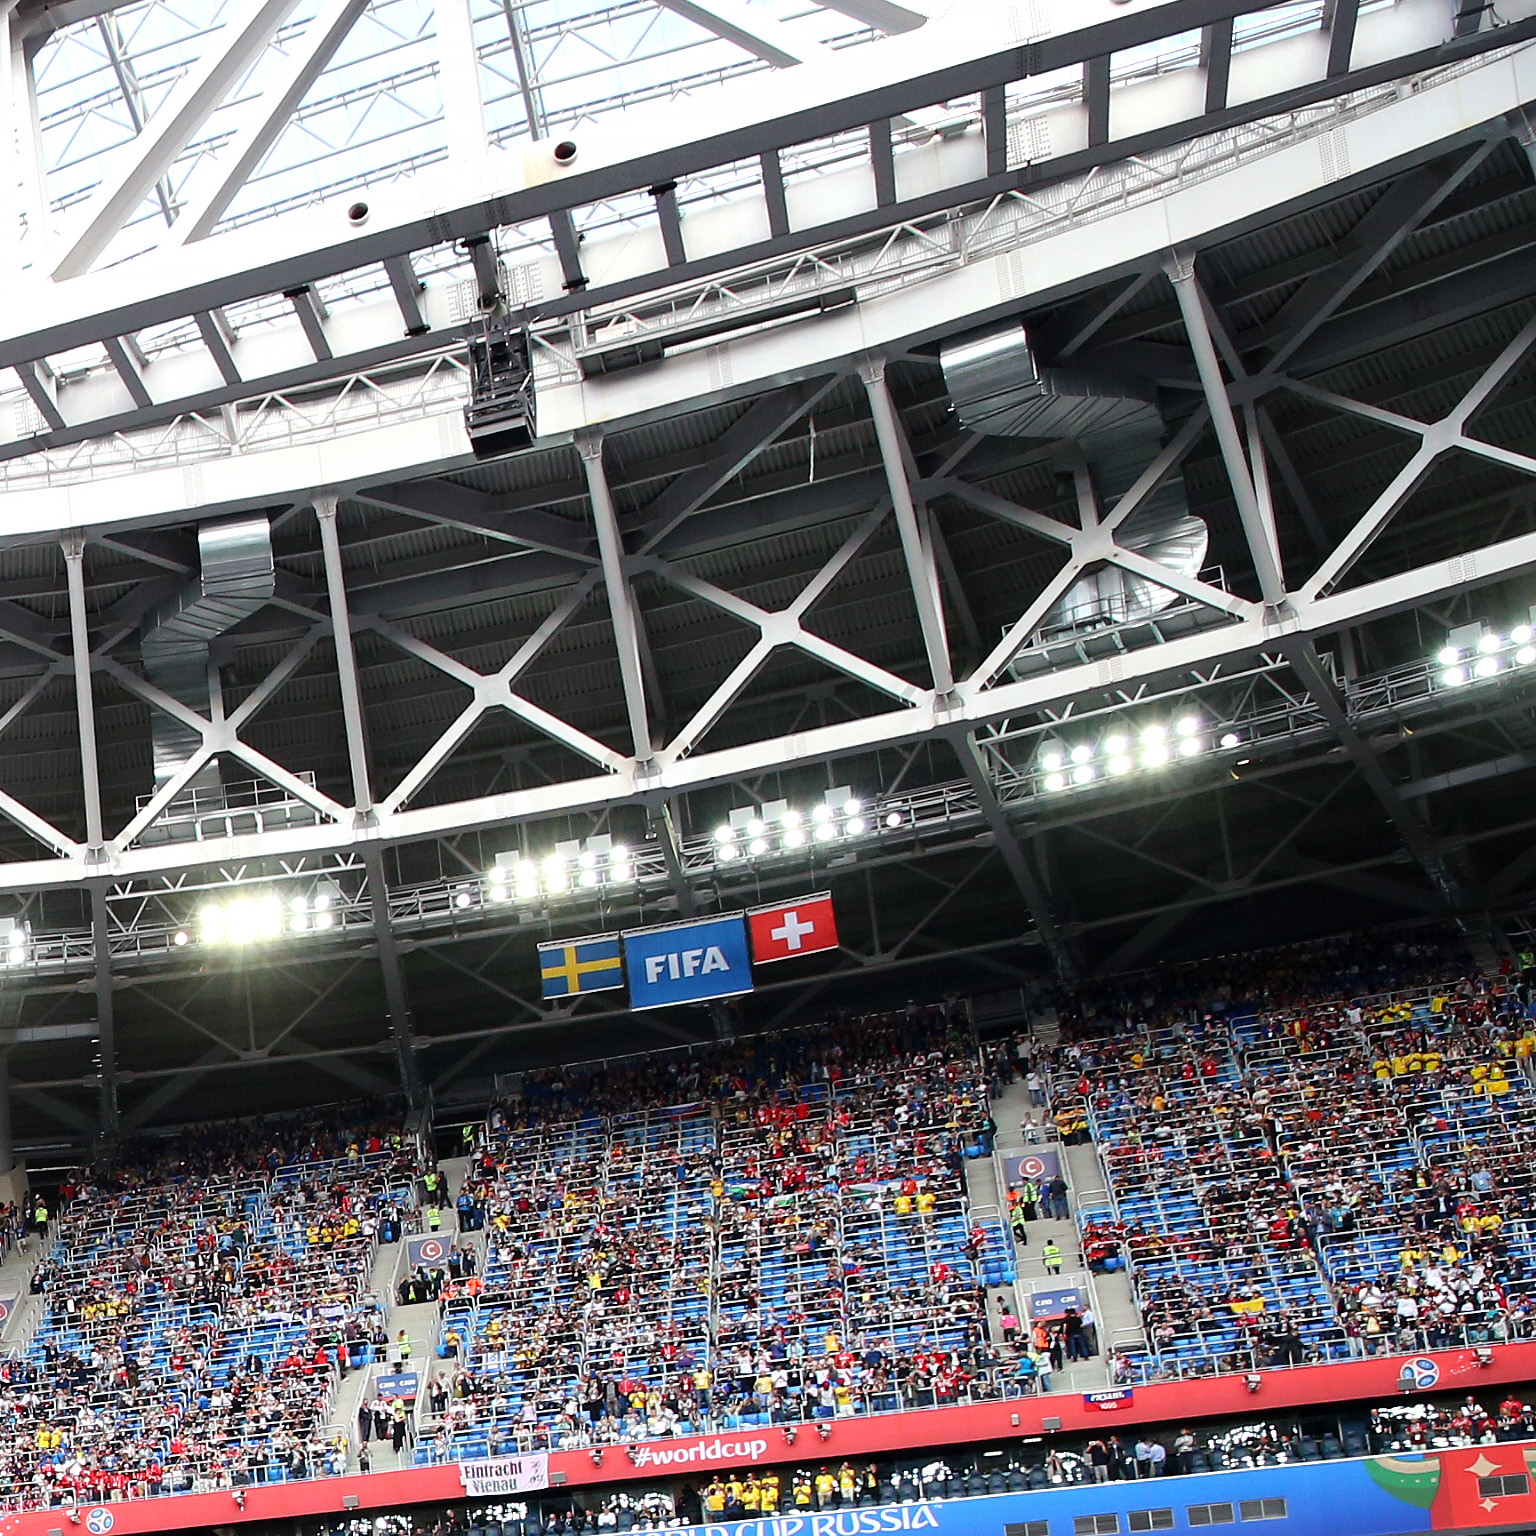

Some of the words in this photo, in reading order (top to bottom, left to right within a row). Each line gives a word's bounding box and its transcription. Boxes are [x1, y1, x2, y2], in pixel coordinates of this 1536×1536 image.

[645, 946, 730, 984] FIFA
[633, 1439, 767, 1468] #worldcup
[464, 1461, 523, 1479] Eintracht
